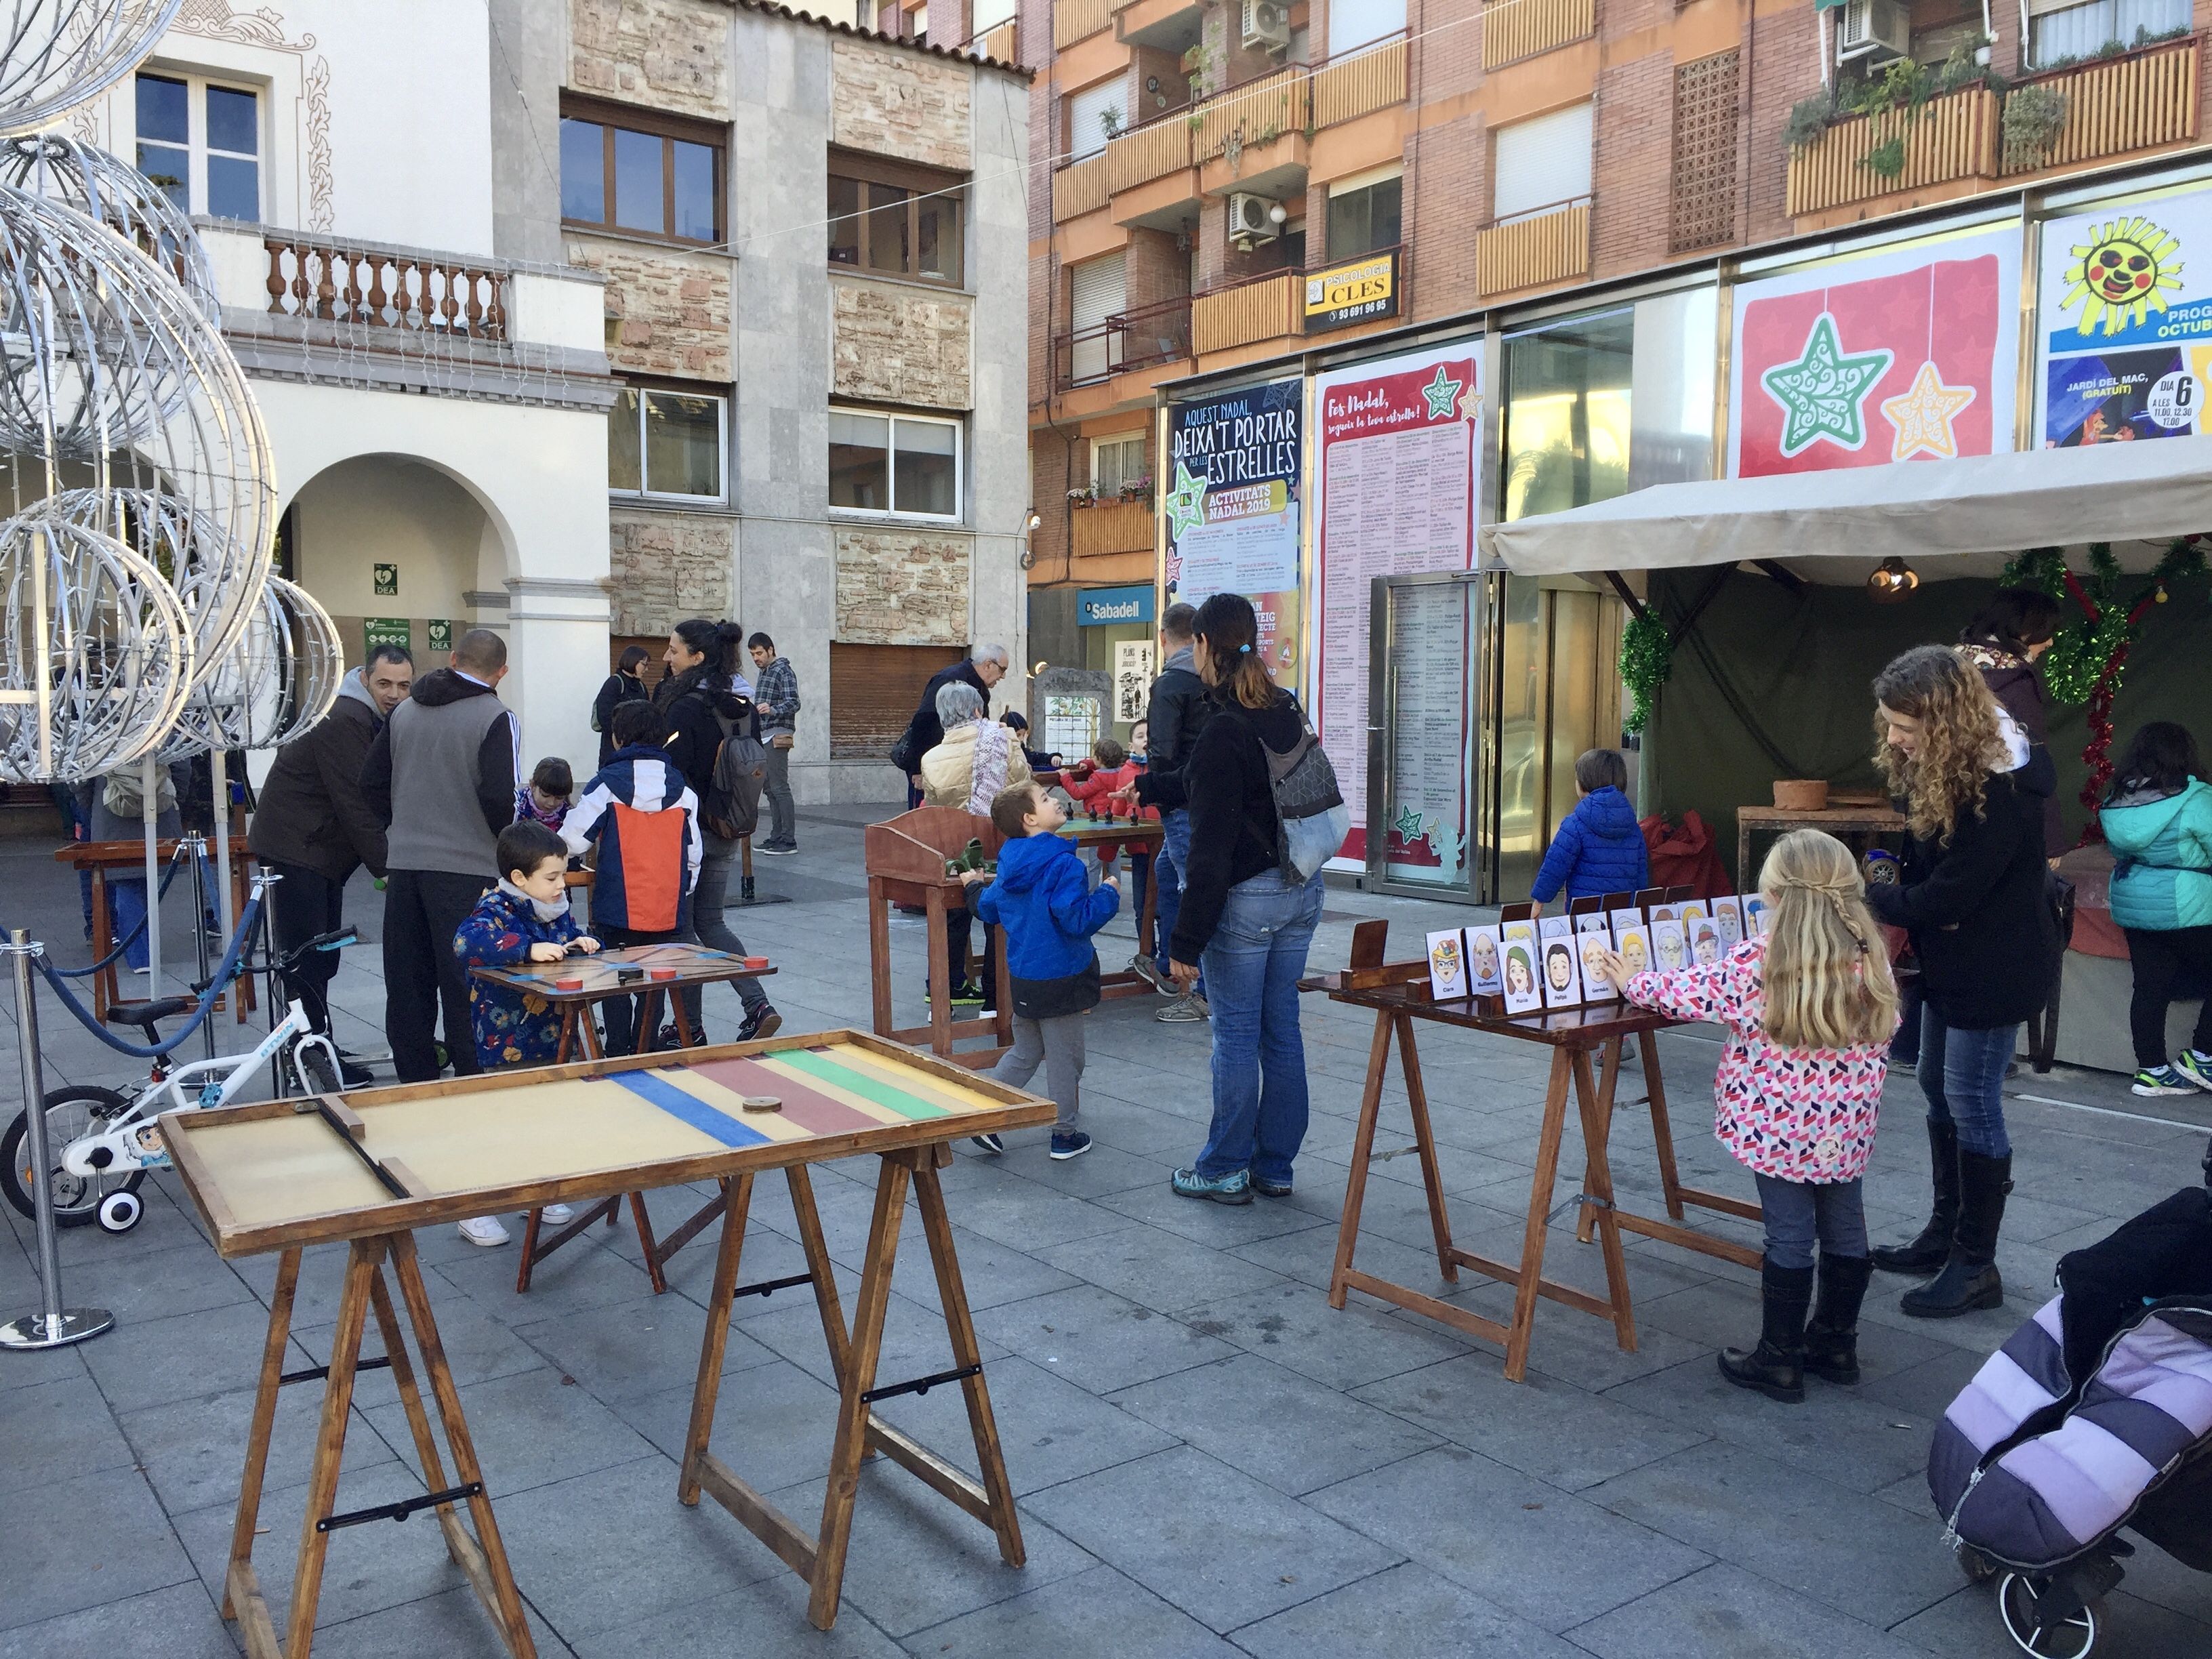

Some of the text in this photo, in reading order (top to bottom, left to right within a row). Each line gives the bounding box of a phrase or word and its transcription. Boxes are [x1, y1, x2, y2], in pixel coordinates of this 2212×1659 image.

[1326, 262, 1390, 287] PSICOLOGIA
[1331, 277, 1385, 304] CLES
[1338, 299, 1387, 320] 93 691 96 95
[2169, 305, 2212, 323] PROG
[2158, 319, 2212, 337] OCTUB
[2066, 373, 2149, 392] JARDÍ DEL MAC,
[2160, 375, 2193, 407] DIA 6
[1185, 399, 1252, 427] AQUEST NADAL,
[1328, 388, 1389, 417] Fes Nadal,
[2152, 398, 2171, 407] A LES
[2174, 408, 2192, 417] 12.30
[1328, 405, 1420, 437] segueix la teva estrella!
[1174, 409, 1296, 459] DEIXA'T PORTAR
[1189, 455, 1208, 468] PER LES
[1208, 441, 1295, 485] ESTRELLES
[1208, 484, 1271, 508] ACTIVITATS
[1209, 504, 1245, 520] NADAL
[1246, 498, 1271, 514] 2019
[1092, 601, 1139, 619] Sabadell
